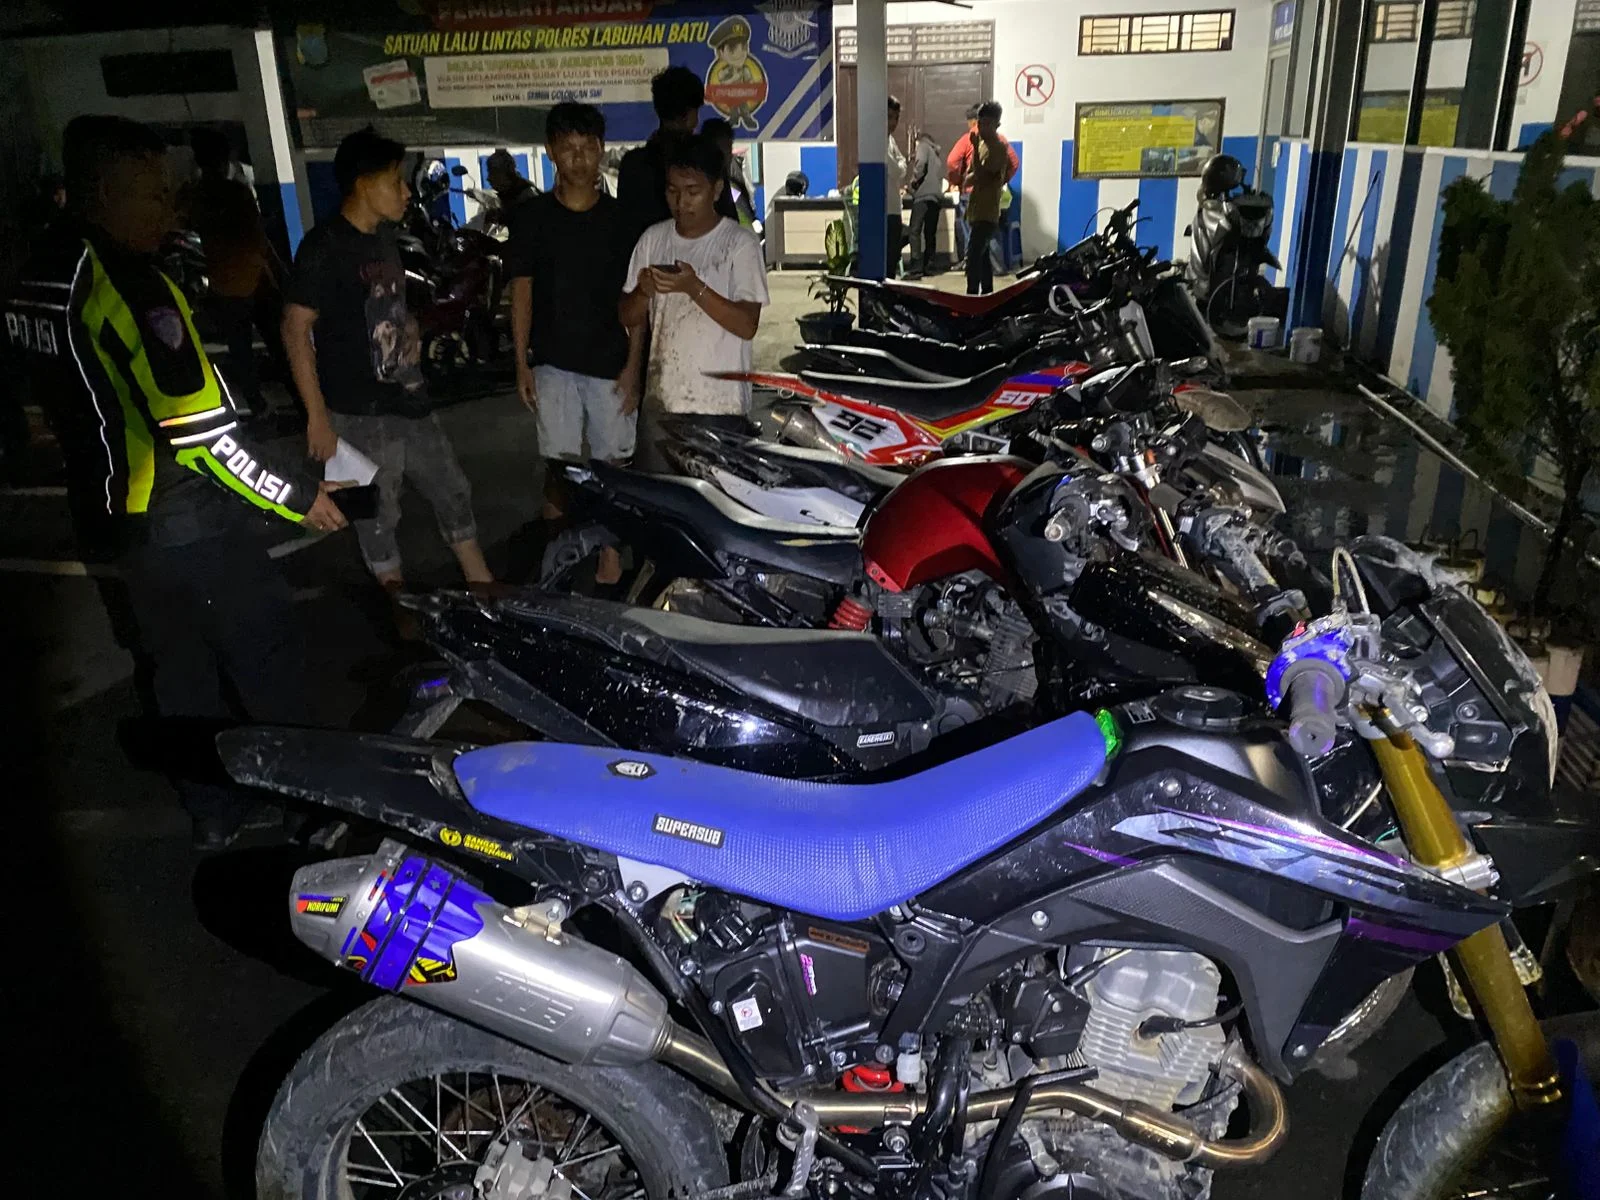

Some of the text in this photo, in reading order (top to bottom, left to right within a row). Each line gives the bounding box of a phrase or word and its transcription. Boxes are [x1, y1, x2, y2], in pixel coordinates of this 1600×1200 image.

[384, 21, 711, 55] SATUAN LALU LINTAS POLRES LABUHAN BATU
[533, 71, 560, 80] SURAT
[563, 70, 591, 79] LULUS
[593, 69, 609, 78] TES
[492, 94, 520, 102] UNTUK
[551, 89, 588, 101] GOLONGAN
[211, 434, 291, 504] POLISI
[655, 816, 722, 846] SUPERSUB
[464, 841, 512, 861] BERTENAGA
[466, 834, 501, 850] SANGAT
[307, 901, 339, 913] NORIFUMI
